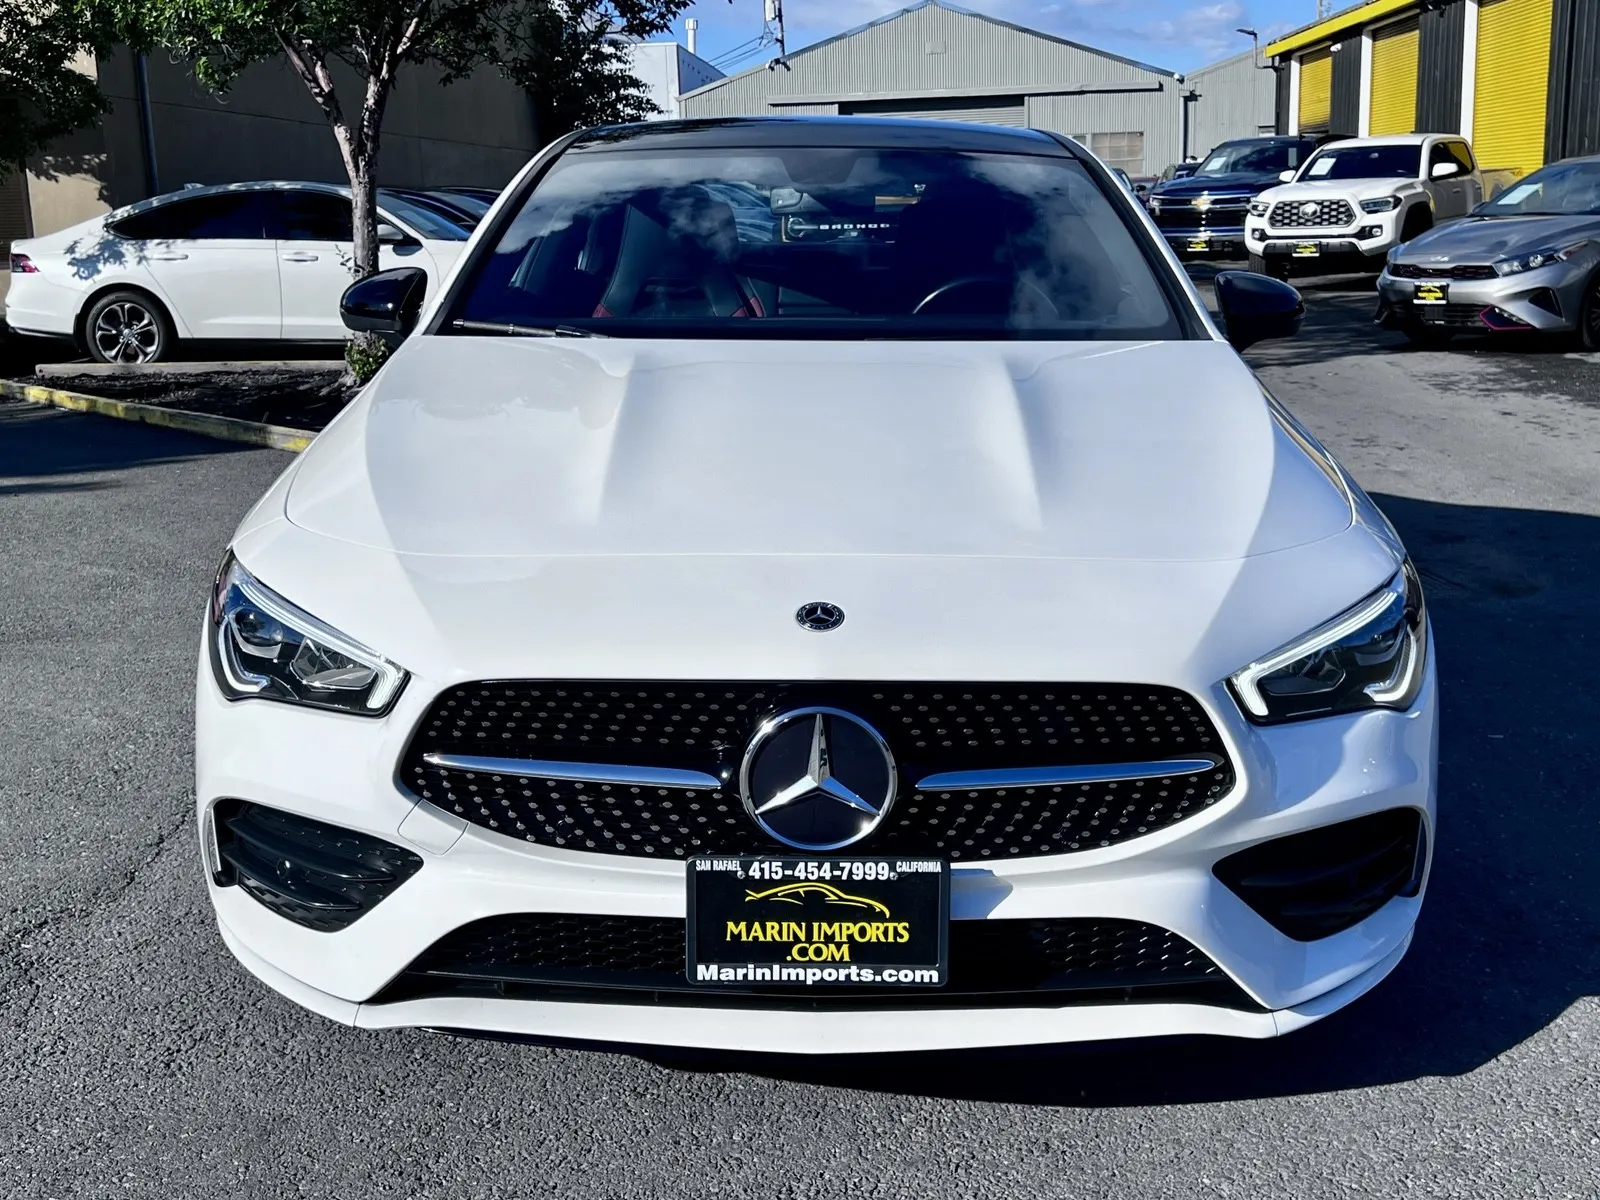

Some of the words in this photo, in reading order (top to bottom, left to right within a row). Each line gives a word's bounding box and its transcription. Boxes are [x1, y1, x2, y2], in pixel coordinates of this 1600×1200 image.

[695, 860, 711, 871] SAN
[713, 859, 742, 871] RAFAEL
[748, 861, 890, 880] 415-454-7999
[896, 861, 942, 873] CALIFORNIA
[726, 921, 806, 942] MARIN
[812, 921, 910, 943] IMPORTS
[786, 943, 851, 962] .COM
[696, 964, 939, 985] MarinImports.com
